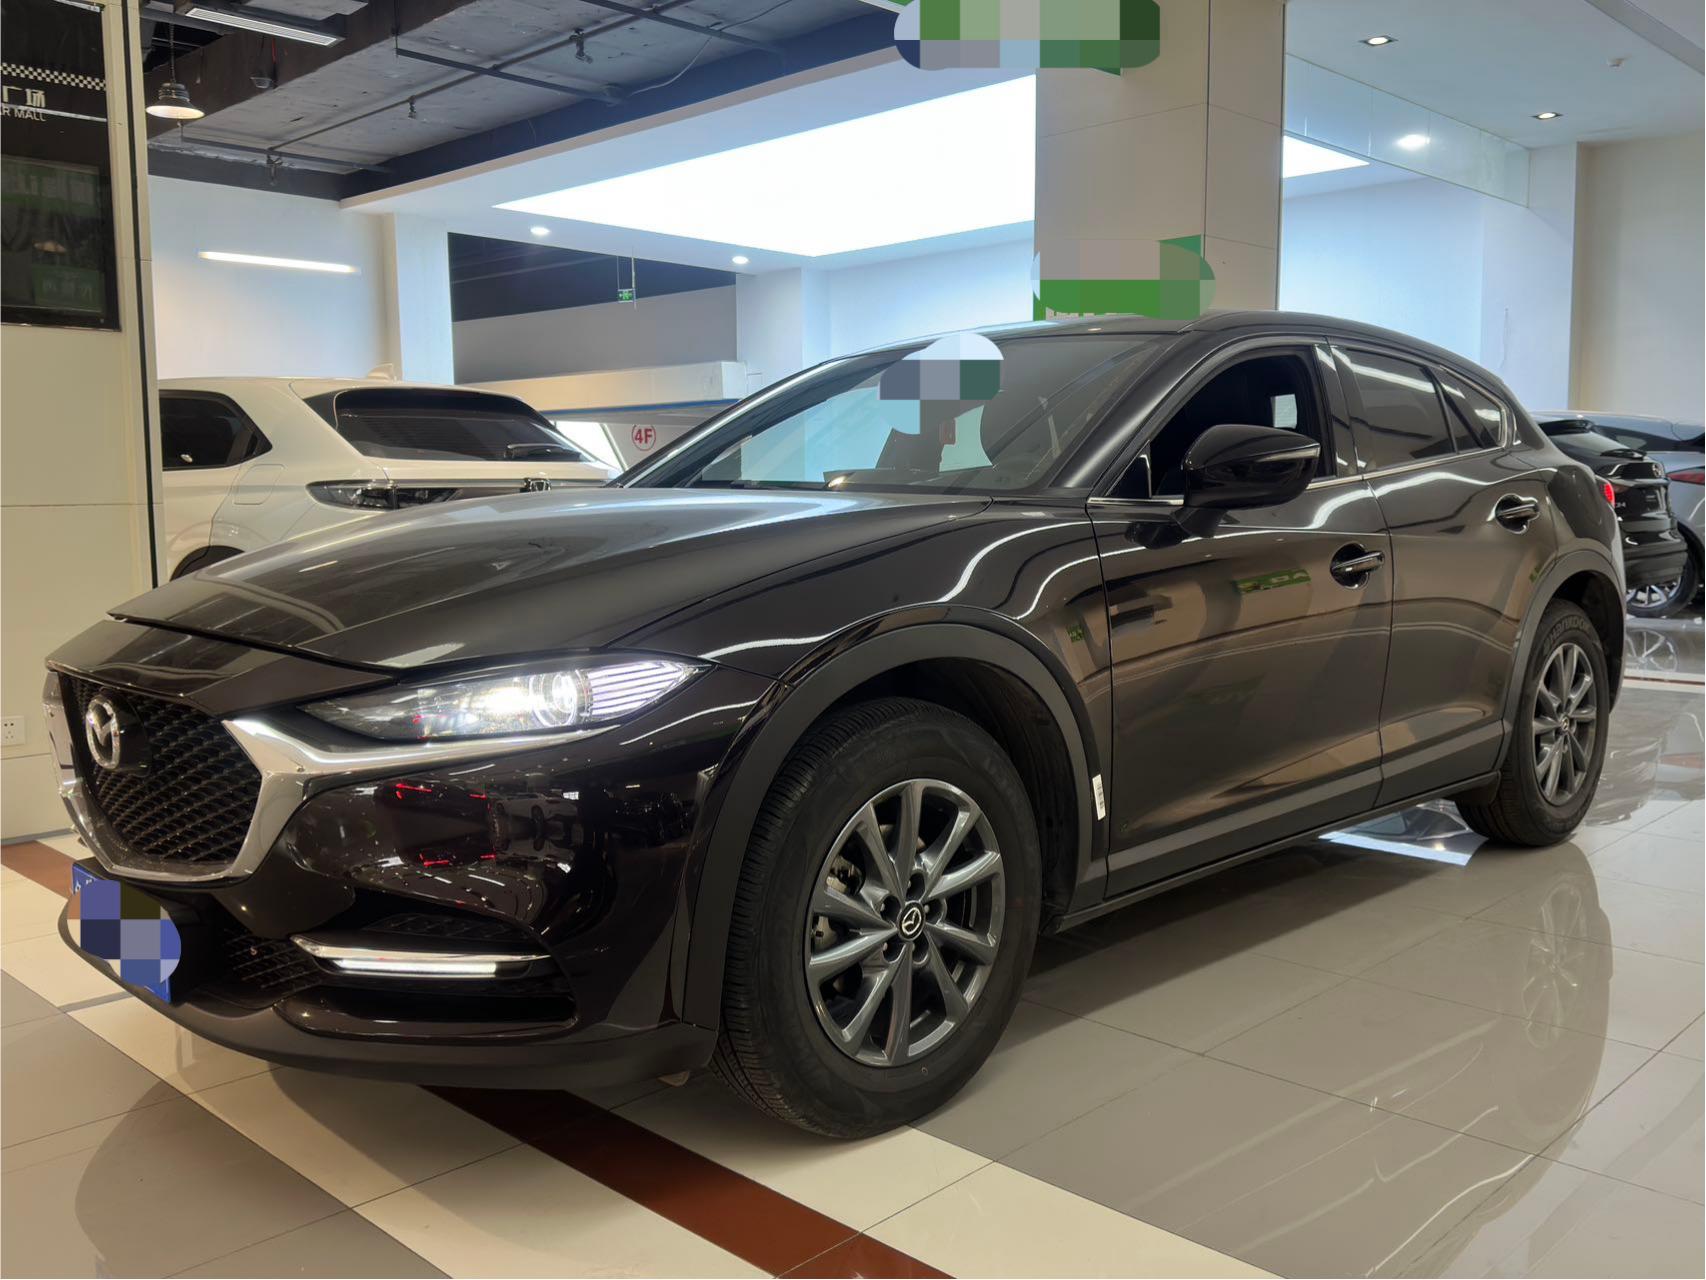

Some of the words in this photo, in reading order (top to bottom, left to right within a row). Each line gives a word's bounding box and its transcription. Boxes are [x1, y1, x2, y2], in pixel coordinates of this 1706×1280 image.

[1, 104, 10, 116] R
[14, 108, 47, 122] MALL
[634, 428, 653, 444] 4F
